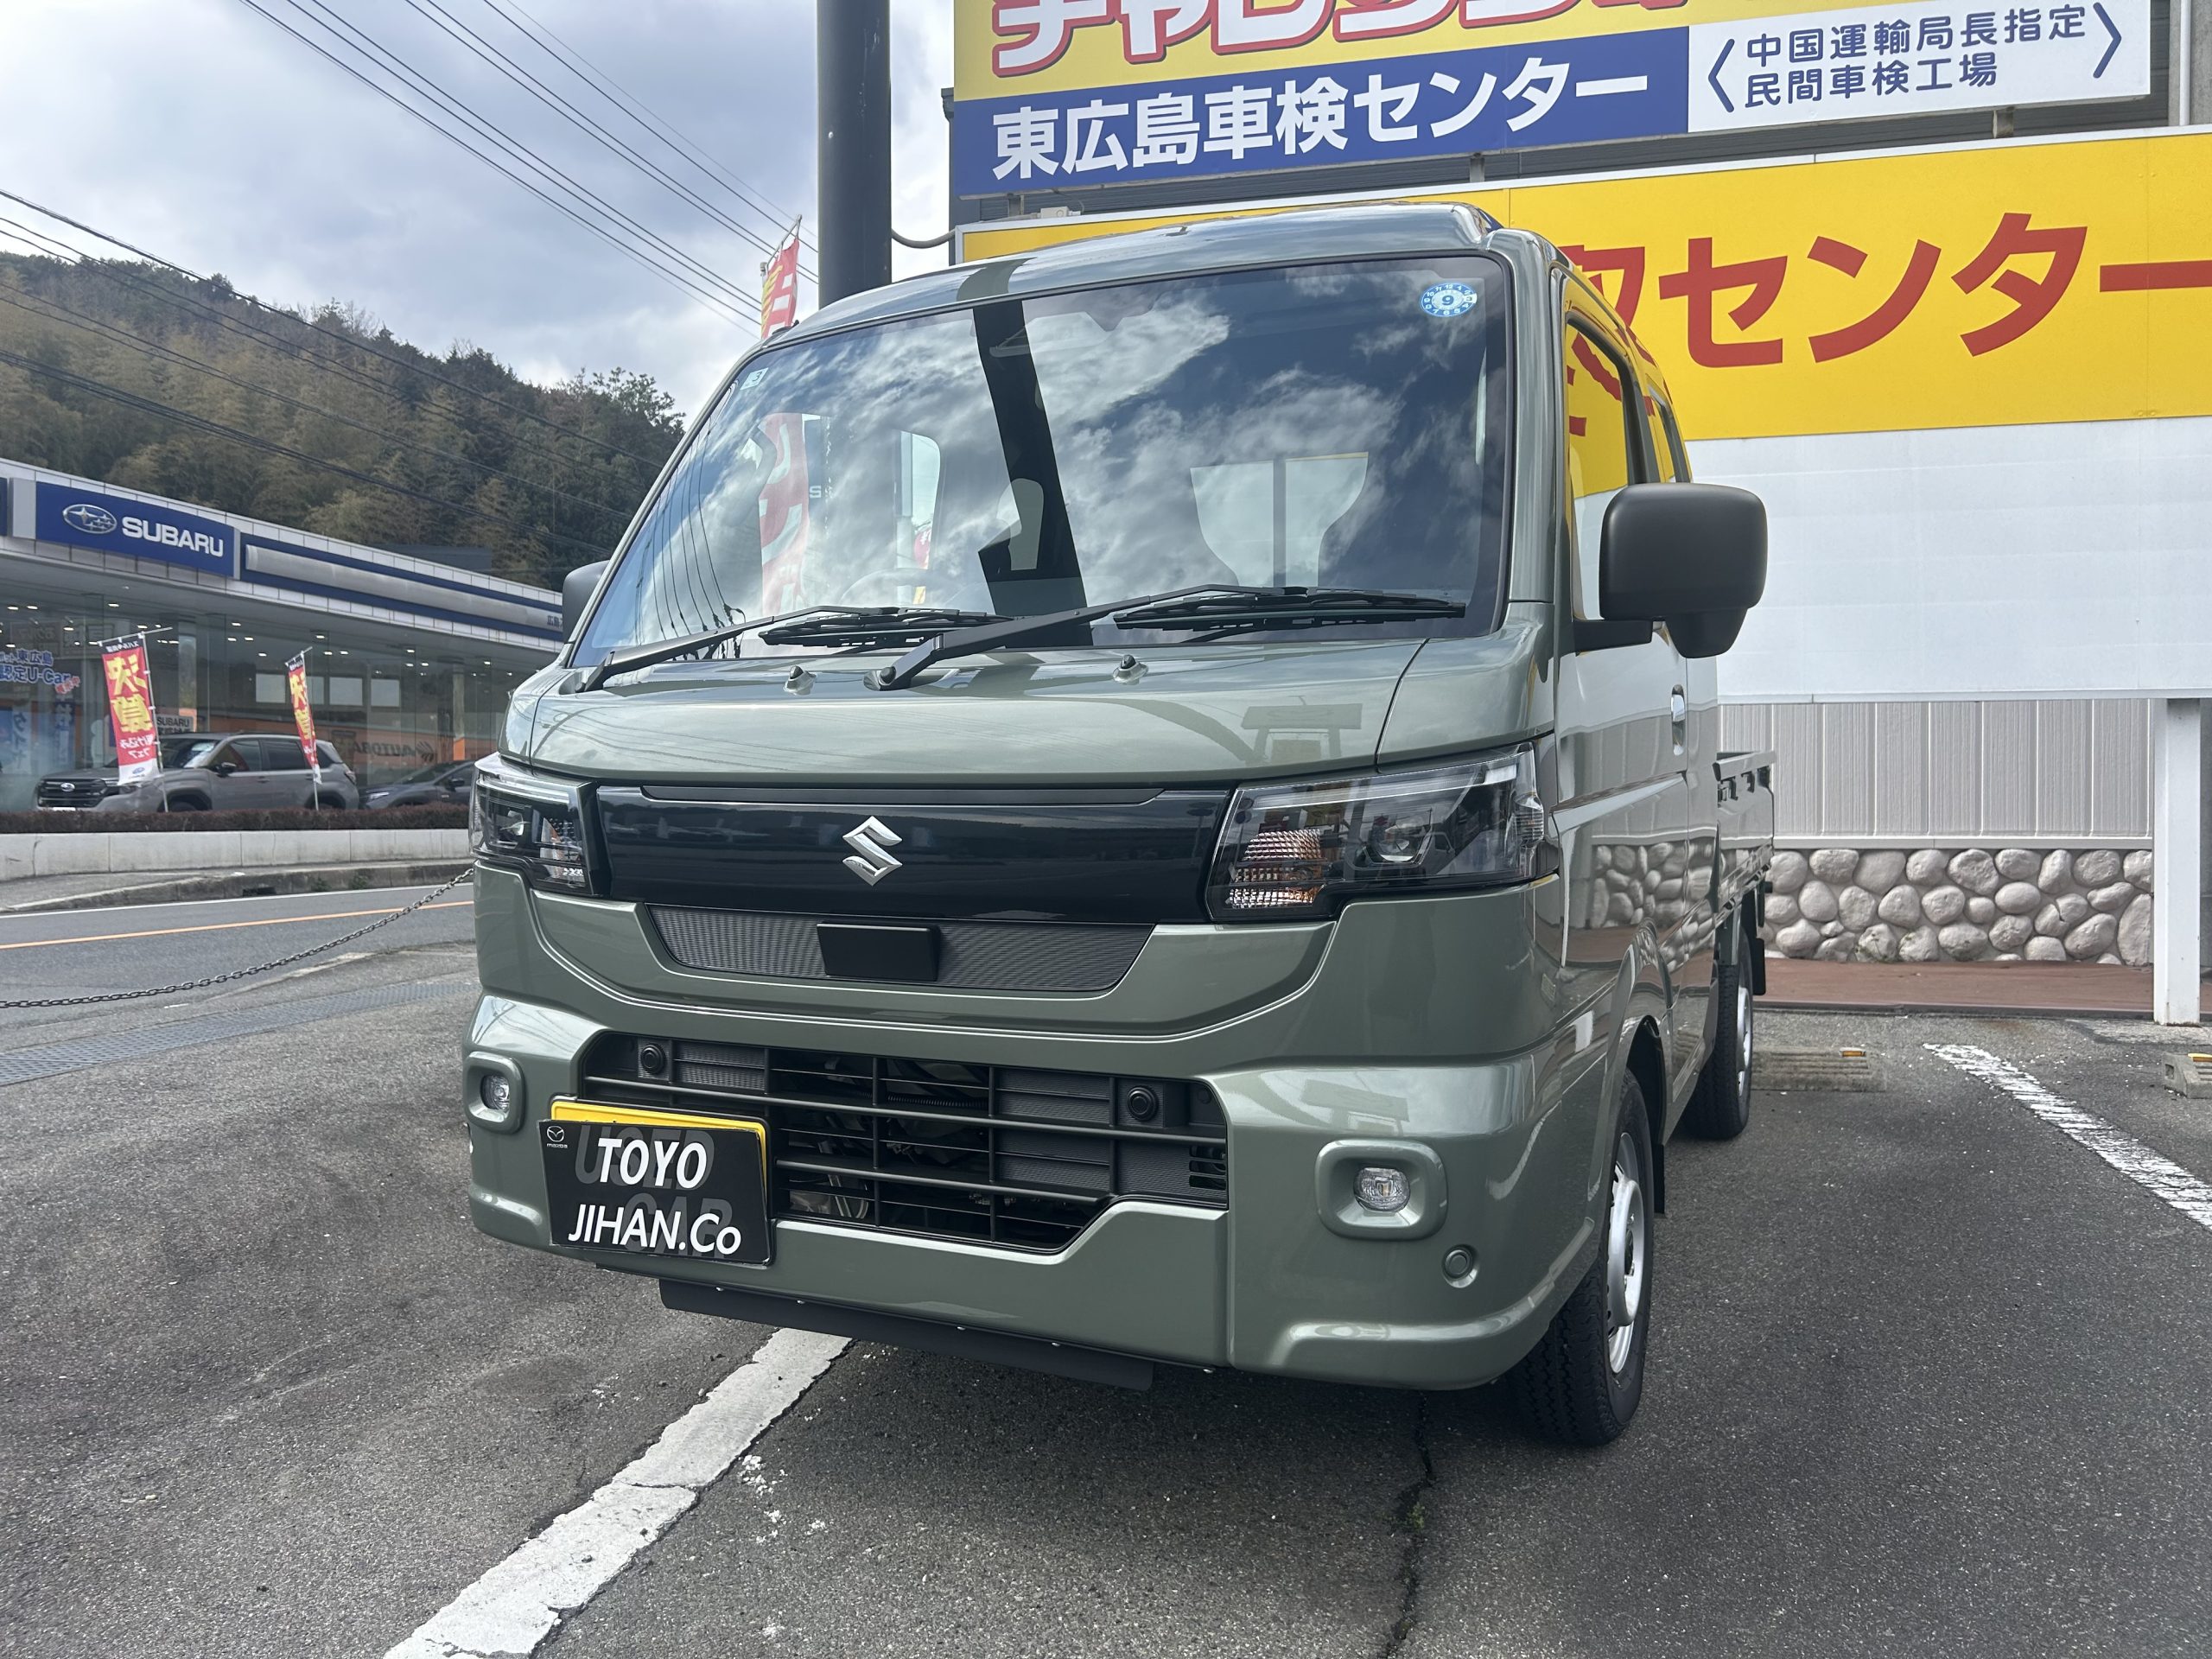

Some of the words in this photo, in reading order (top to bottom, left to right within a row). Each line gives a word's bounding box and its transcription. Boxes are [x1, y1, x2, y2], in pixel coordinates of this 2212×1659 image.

[1745, 4, 2086, 68] 中国運輸局長指定
[1744, 51, 1998, 109] 民間車検工場
[991, 57, 1649, 181] 東広島車検センター
[1441, 295, 1454, 306] 9
[121, 516, 224, 557] SUBARU
[156, 716, 190, 728] SUBARU
[597, 1137, 708, 1190] TOYO
[567, 1204, 742, 1255] JIHAN.Co
